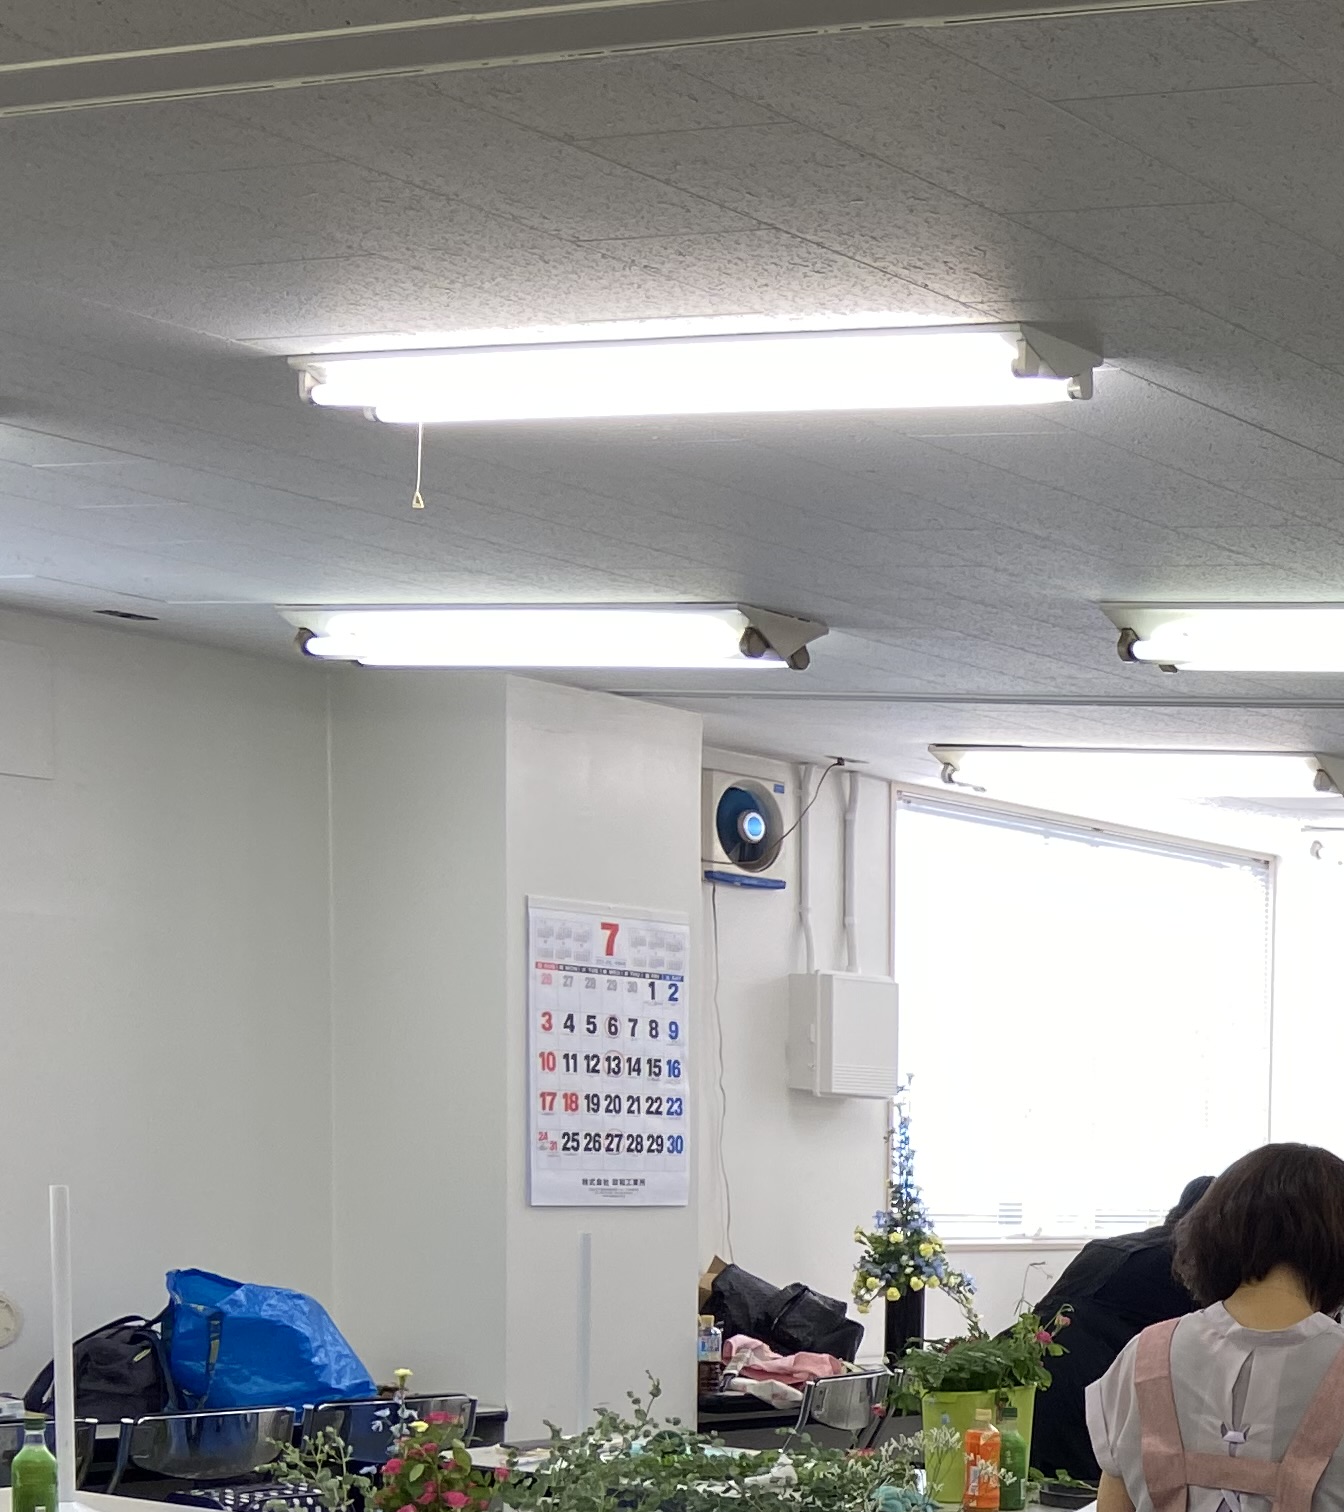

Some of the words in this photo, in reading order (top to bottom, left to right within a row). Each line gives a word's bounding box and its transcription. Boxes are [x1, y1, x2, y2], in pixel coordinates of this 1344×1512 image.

[600, 922, 619, 956] 7
[541, 973, 553, 986] 26
[563, 975, 574, 988] 27
[584, 977, 597, 990] 28
[607, 979, 618, 992] 29
[627, 981, 638, 993] 30
[648, 981, 656, 1000] 1
[668, 983, 679, 1002] 2
[541, 1011, 553, 1032] 3
[563, 1013, 575, 1033] 4
[586, 1015, 597, 1034] 5
[607, 1016, 619, 1036] 6
[628, 1018, 638, 1037] 7
[648, 1019, 659, 1039] 8
[668, 1021, 679, 1040] 9
[539, 1051, 556, 1072] 10
[563, 1053, 578, 1073] 11
[584, 1054, 600, 1074] 12
[605, 1055, 622, 1075] 13
[626, 1057, 641, 1076] 14
[646, 1058, 662, 1077] 15
[666, 1059, 681, 1078] 16
[539, 1092, 557, 1111] 17
[562, 1092, 579, 1112] 18
[584, 1093, 600, 1113] 19
[604, 1094, 622, 1114] 20
[626, 1095, 641, 1114] 21
[645, 1096, 663, 1115] 22
[666, 1098, 683, 1116] 23
[538, 1131, 548, 1142] 24
[550, 1140, 558, 1151] 31
[562, 1132, 580, 1152] 25
[583, 1132, 602, 1152] 26
[605, 1133, 623, 1152] 27
[626, 1134, 644, 1153] 28
[647, 1134, 664, 1153] 29
[667, 1135, 684, 1154] 30
